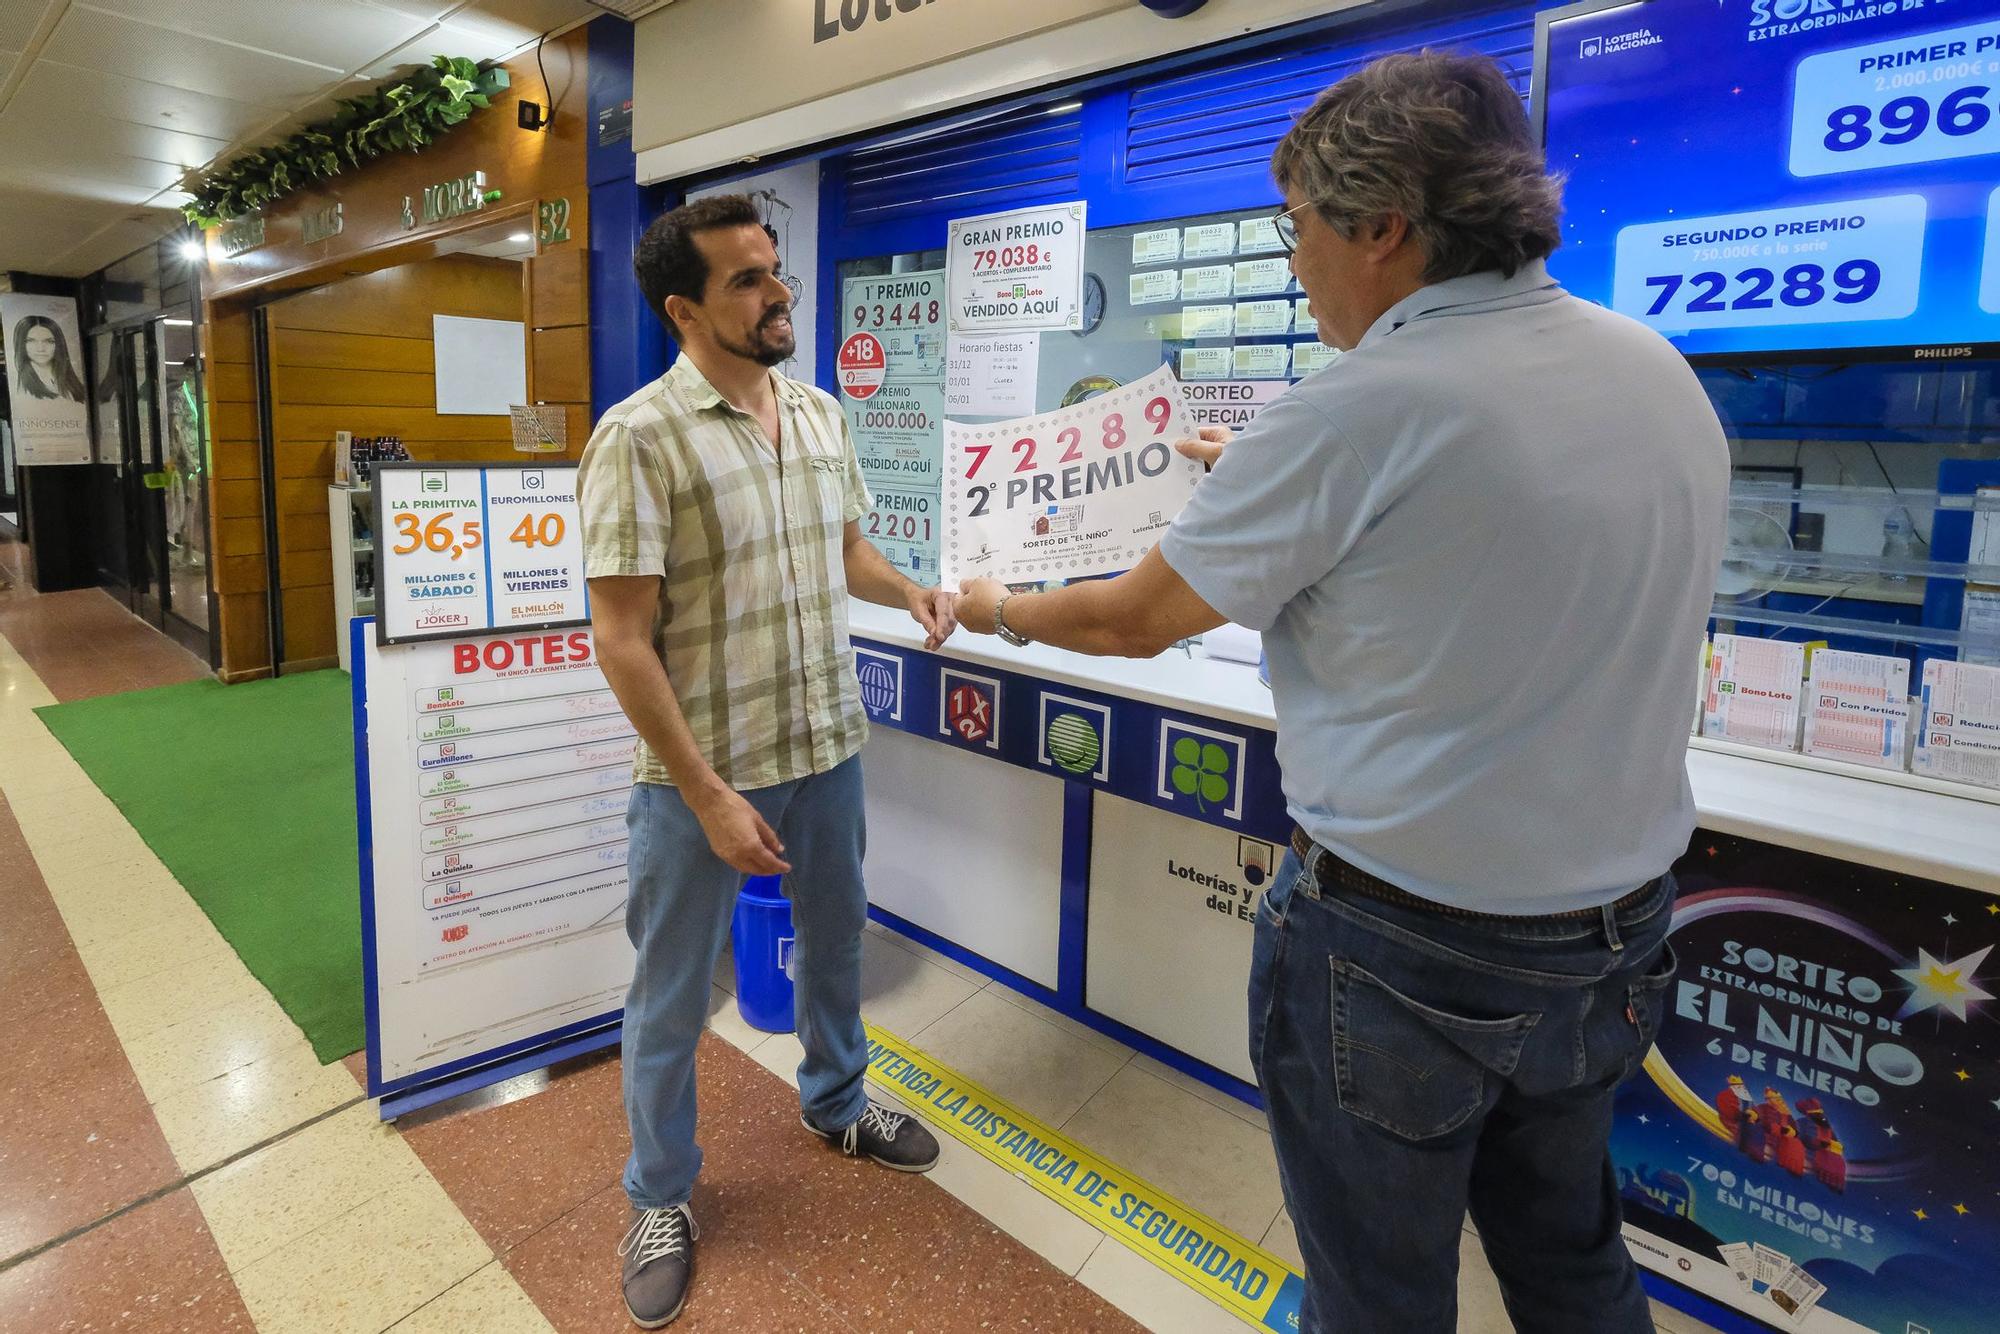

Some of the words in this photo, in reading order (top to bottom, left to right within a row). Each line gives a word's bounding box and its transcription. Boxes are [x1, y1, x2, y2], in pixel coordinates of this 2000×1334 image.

[1748, 2, 1898, 42] EXTRAORDINARIO
[1605, 29, 1651, 46] LOTERÍA
[1605, 35, 1663, 54] NACIONAL
[1859, 41, 1967, 74] PRIMER
[1823, 85, 2000, 152] 896
[540, 197, 572, 245] 32
[963, 228, 1001, 247] GRAN
[1006, 220, 1064, 241] PREMIO
[1662, 226, 1768, 248] SEGUNDO
[1774, 215, 1866, 237] PREMIO
[973, 244, 1039, 271] 79.038
[1043, 252, 1052, 263] €
[1693, 245, 1761, 262] 750.000€
[1763, 245, 1773, 256] a
[1776, 241, 1791, 255] la
[1794, 239, 1828, 253] serie
[978, 269, 999, 278] ACIERTOS
[1003, 264, 1053, 275] COMPLEMENTARIO
[877, 281, 932, 300] PREMIO
[997, 291, 1012, 299] Bono
[1027, 289, 1043, 297] Loto
[1645, 258, 1882, 317] 72289
[963, 303, 1019, 319] VENDIDO
[1023, 297, 1060, 316] AQUÍ
[847, 338, 875, 361] +18
[959, 343, 991, 353] Horario
[993, 341, 1023, 352] fiestas
[1914, 347, 1973, 359] PHILIPS
[949, 360, 971, 371] 31/12
[948, 377, 970, 387] 01/01
[877, 387, 910, 397] PREMIO
[948, 395, 969, 405] 06/01
[1182, 385, 1254, 400] SORTEO
[865, 400, 921, 411] MILLONARIO
[19, 419, 82, 430] INNOSENSE
[855, 411, 926, 429] 1.000.000
[903, 458, 931, 473] AQUÍ
[1006, 441, 1172, 510] PREMIO
[392, 500, 409, 510] LA
[413, 499, 478, 509] PRIMITIVA
[491, 494, 576, 505] EUROMILLONES
[875, 494, 929, 513] PREMIO
[393, 511, 482, 561] 36,5
[509, 513, 566, 549] 40
[1023, 539, 1056, 549] SORTEO
[1057, 537, 1069, 545] DE
[404, 574, 466, 584] MILLONES
[468, 572, 476, 580] €
[503, 568, 559, 579] MILLONES
[561, 568, 569, 576] €
[410, 584, 475, 599] SÁBADO
[506, 579, 569, 592] VIERNES
[511, 607, 524, 615] EL
[524, 602, 564, 613] MILLÓN
[424, 614, 461, 625] JOKER
[453, 632, 591, 675] BOTES
[507, 667, 529, 677] ÚNICO
[530, 664, 567, 674] ACERTANTE
[1741, 687, 1767, 697] Bono
[1768, 690, 1792, 700] Loto
[426, 698, 466, 710] BonoLoto
[1840, 701, 1860, 711] Con
[1863, 704, 1907, 718] Partidos
[422, 730, 433, 739] La
[435, 726, 472, 737] Primitiva
[1959, 719, 2000, 732] Reduci
[422, 754, 474, 767] EuroMillones
[431, 869, 441, 878] La
[442, 862, 474, 875] Quiniela
[1168, 859, 1237, 897] Loterías
[1242, 887, 1254, 905] y
[434, 897, 442, 905] El
[443, 890, 473, 903] Quinigol
[500, 906, 511, 914] LOS
[1206, 894, 1233, 916] del
[1238, 904, 1257, 925] Es
[1722, 941, 1883, 1004] SORTEO
[1700, 965, 1871, 1026] EXTRAORDINARIO
[1876, 1016, 1904, 1036] DE
[1675, 979, 1736, 1033] EL
[1756, 1003, 1925, 1087] NIÑO
[1705, 1037, 1723, 1057] 6
[1731, 1042, 1767, 1072] DE
[1775, 1057, 1881, 1107] ENERO
[867, 1040, 943, 1101] ANTENGA
[932, 1086, 970, 1117] LA
[960, 1103, 1079, 1187] DISTANCIA
[1072, 1169, 1119, 1209] DE
[1110, 1191, 1271, 1302] SEGURIDAD
[1687, 1155, 1737, 1189] 700
[1743, 1178, 1876, 1245] MILLONES
[1717, 1188, 1744, 1212] EN
[1749, 1199, 1843, 1251] PREMIOS
